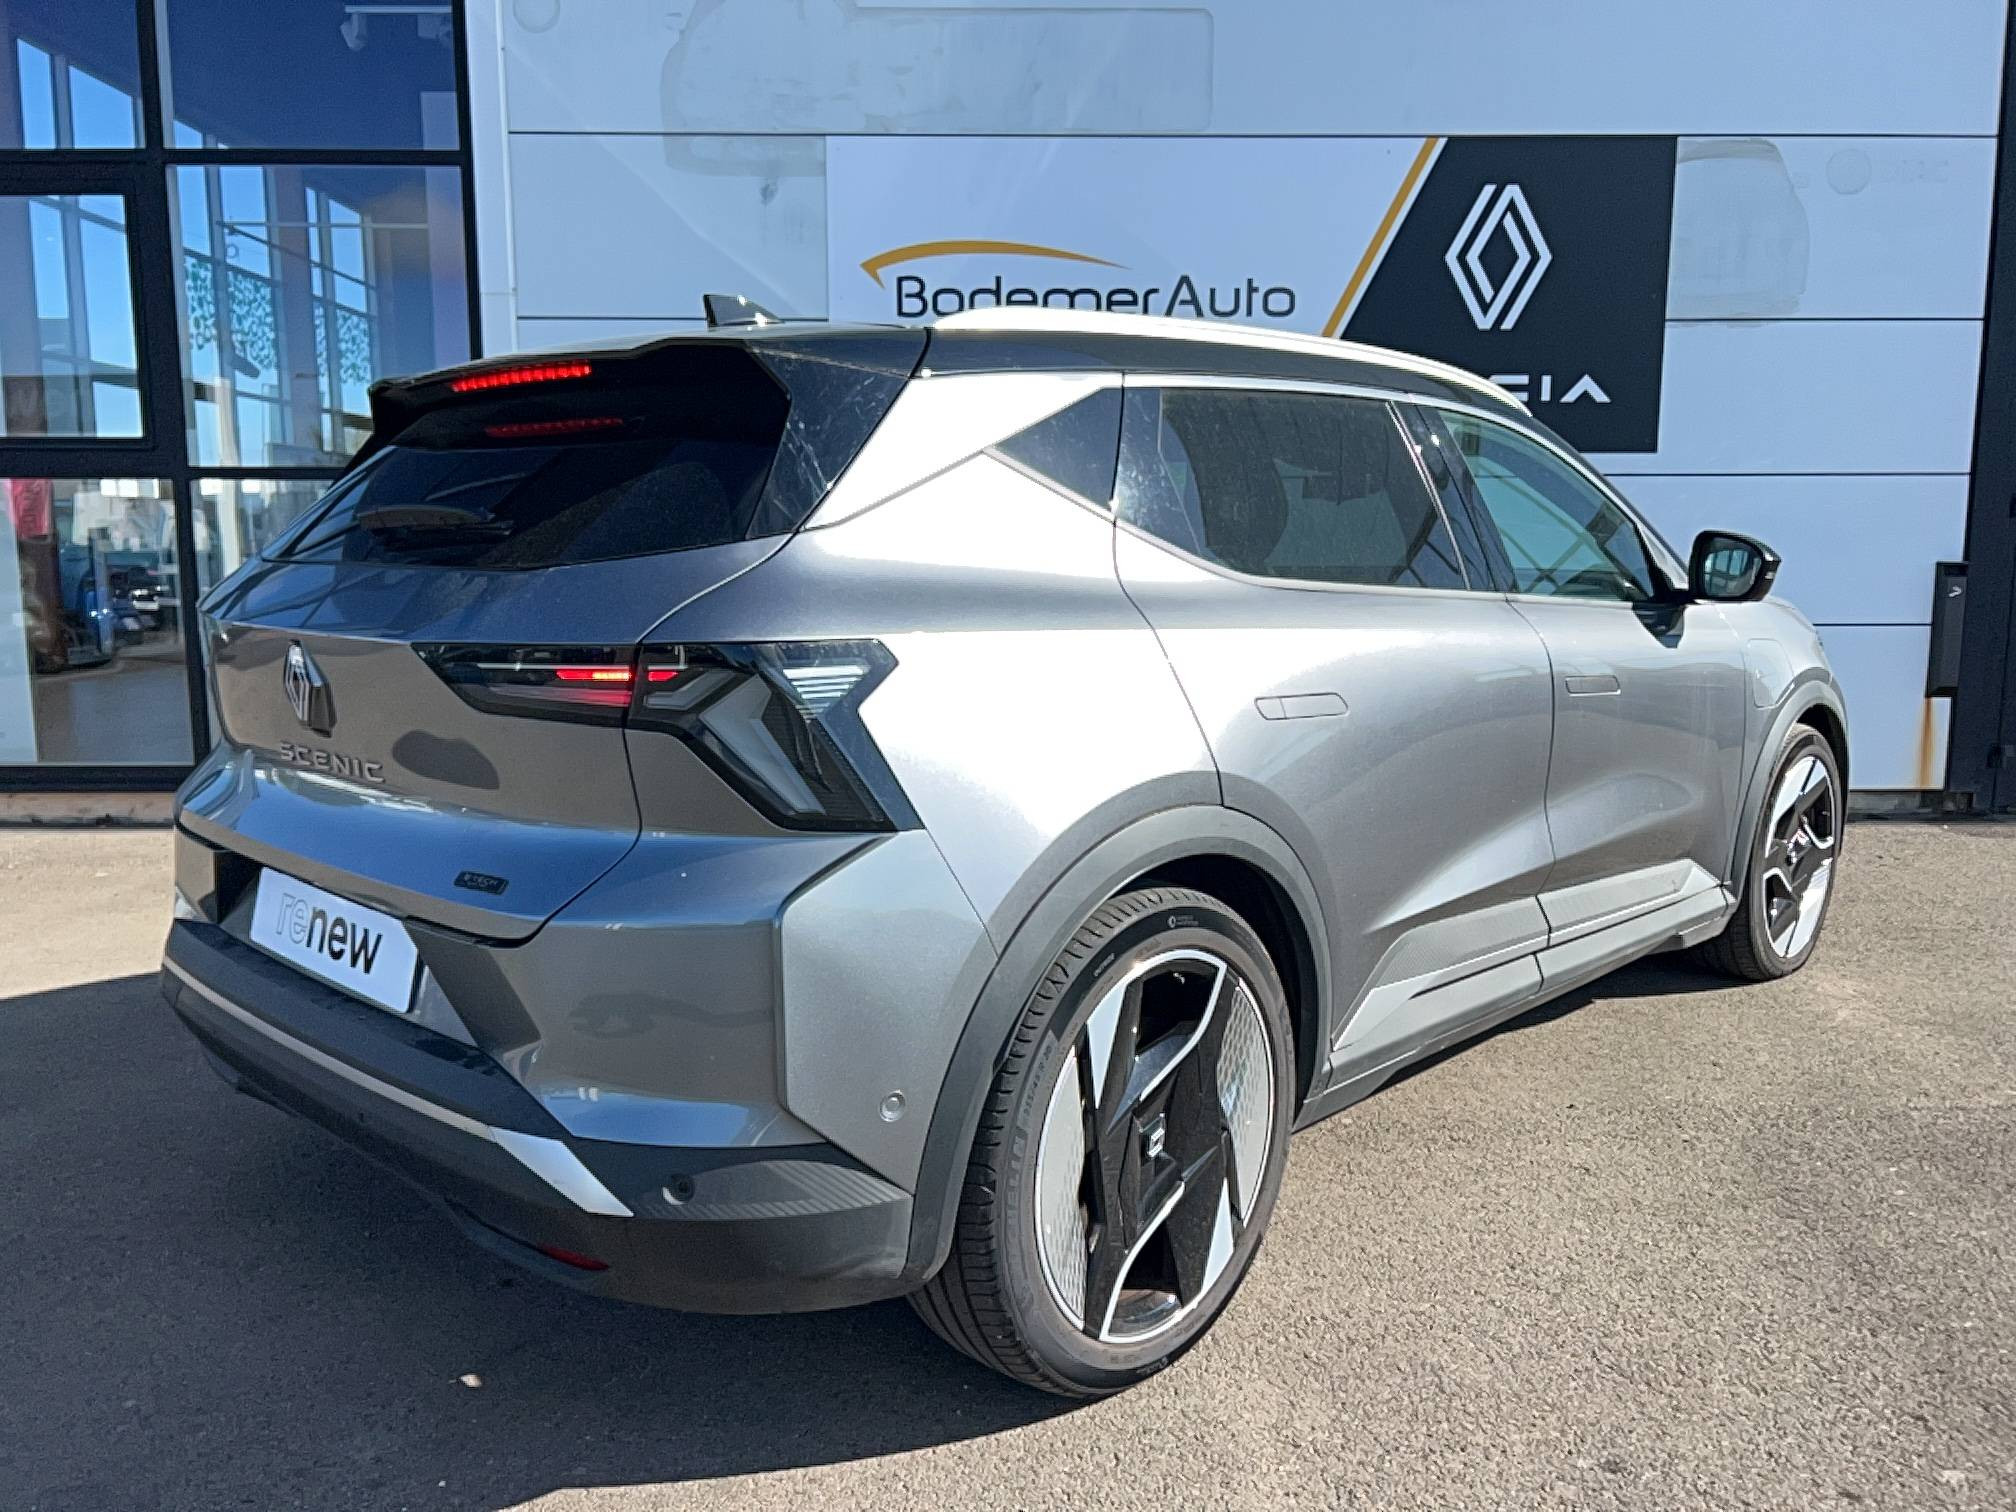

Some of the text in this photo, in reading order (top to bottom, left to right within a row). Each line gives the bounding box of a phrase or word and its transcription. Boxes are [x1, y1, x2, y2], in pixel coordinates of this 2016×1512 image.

[896, 274, 1296, 318] BodemerAuto
[280, 742, 385, 783] SCENIC
[276, 893, 383, 975] renew
